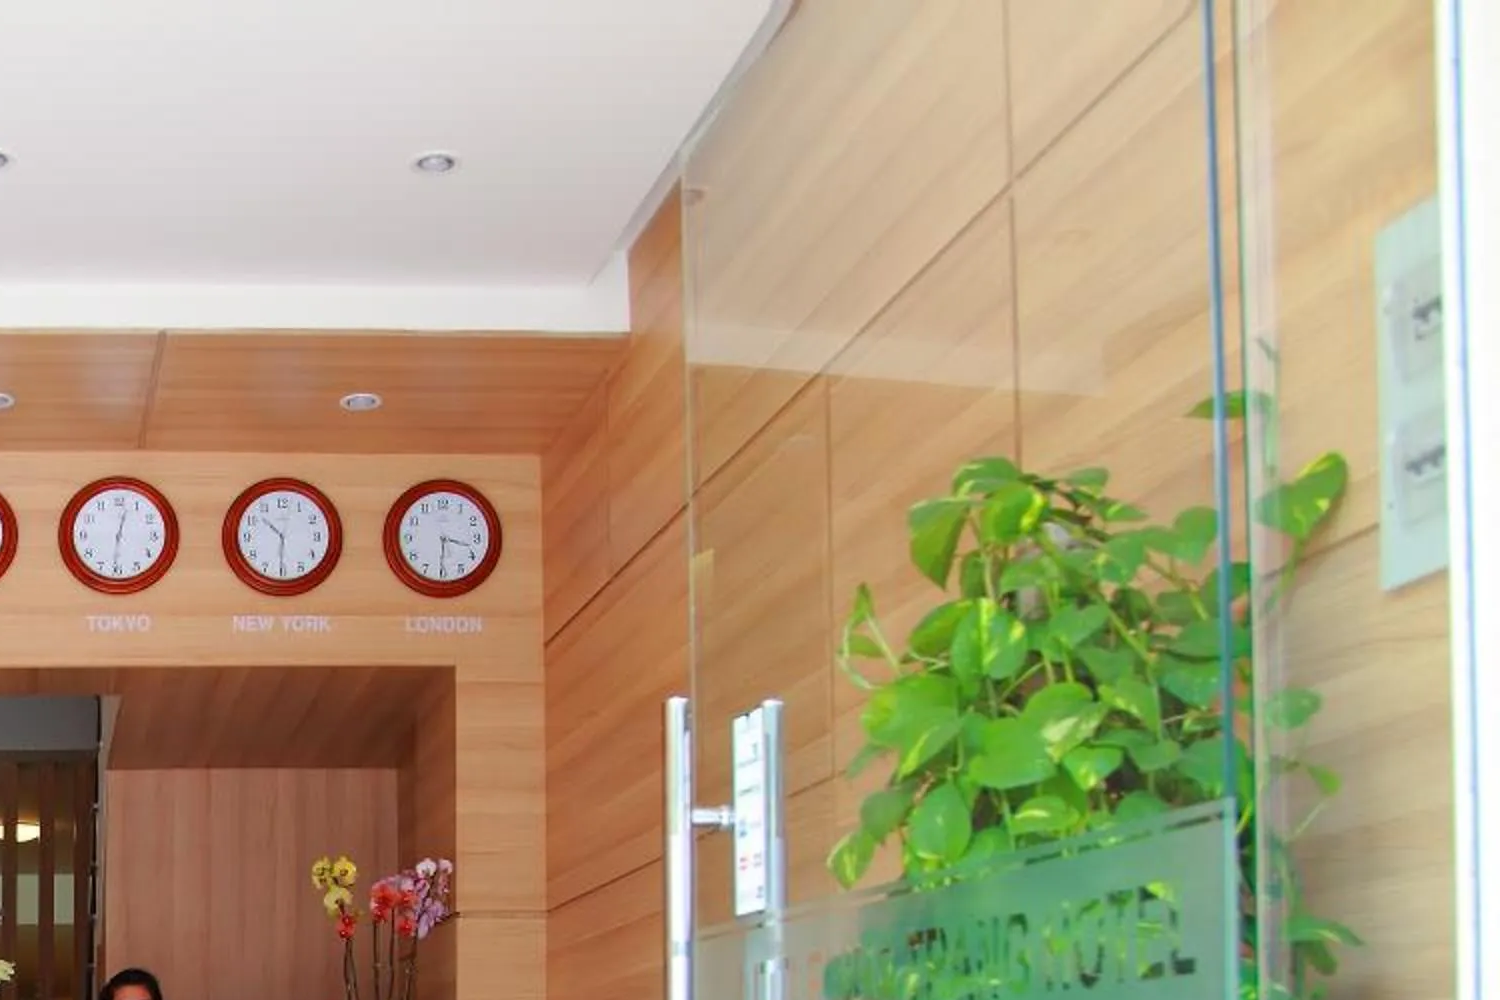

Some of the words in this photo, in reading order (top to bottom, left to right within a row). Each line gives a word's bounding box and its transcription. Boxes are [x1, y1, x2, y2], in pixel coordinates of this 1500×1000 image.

[85, 614, 152, 632] TOKYO
[232, 614, 274, 632] NEW
[282, 615, 332, 632] YORK
[405, 615, 483, 633] LONDON
